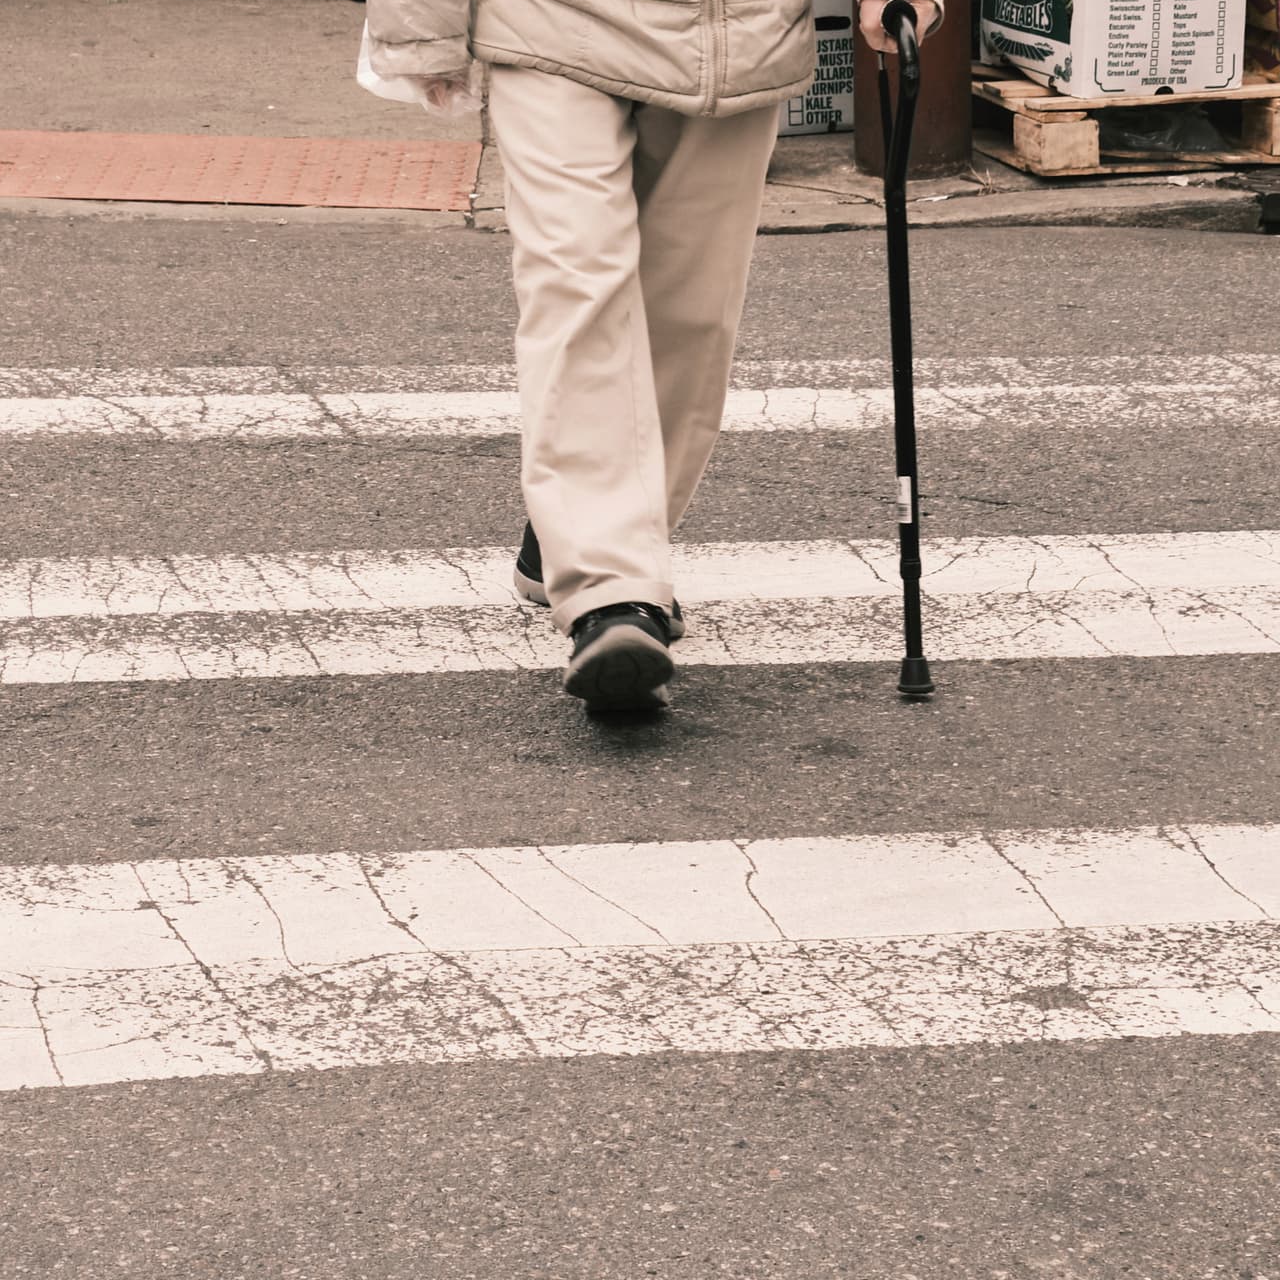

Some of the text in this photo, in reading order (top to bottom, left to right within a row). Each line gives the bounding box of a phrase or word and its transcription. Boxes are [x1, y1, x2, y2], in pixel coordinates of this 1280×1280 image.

[1173, 12, 1198, 20] Mustard
[1109, 23, 1136, 31] Escarole
[1173, 21, 1187, 30] Tops
[1108, 32, 1129, 40] Endive
[1192, 30, 1216, 39] Spinach
[1108, 41, 1148, 50] Curly Parsley
[1172, 40, 1196, 49] Spinach
[1107, 51, 1147, 60] Plain Parsley
[1107, 60, 1134, 68] Red Leaf
[1171, 58, 1193, 67] Turnips
[1107, 69, 1140, 77] Green Leaf
[1170, 67, 1187, 75] Other
[1140, 76, 1188, 86] PRODUCE OF USA
[805, 96, 833, 110] KALE
[806, 109, 843, 126] OTHER
